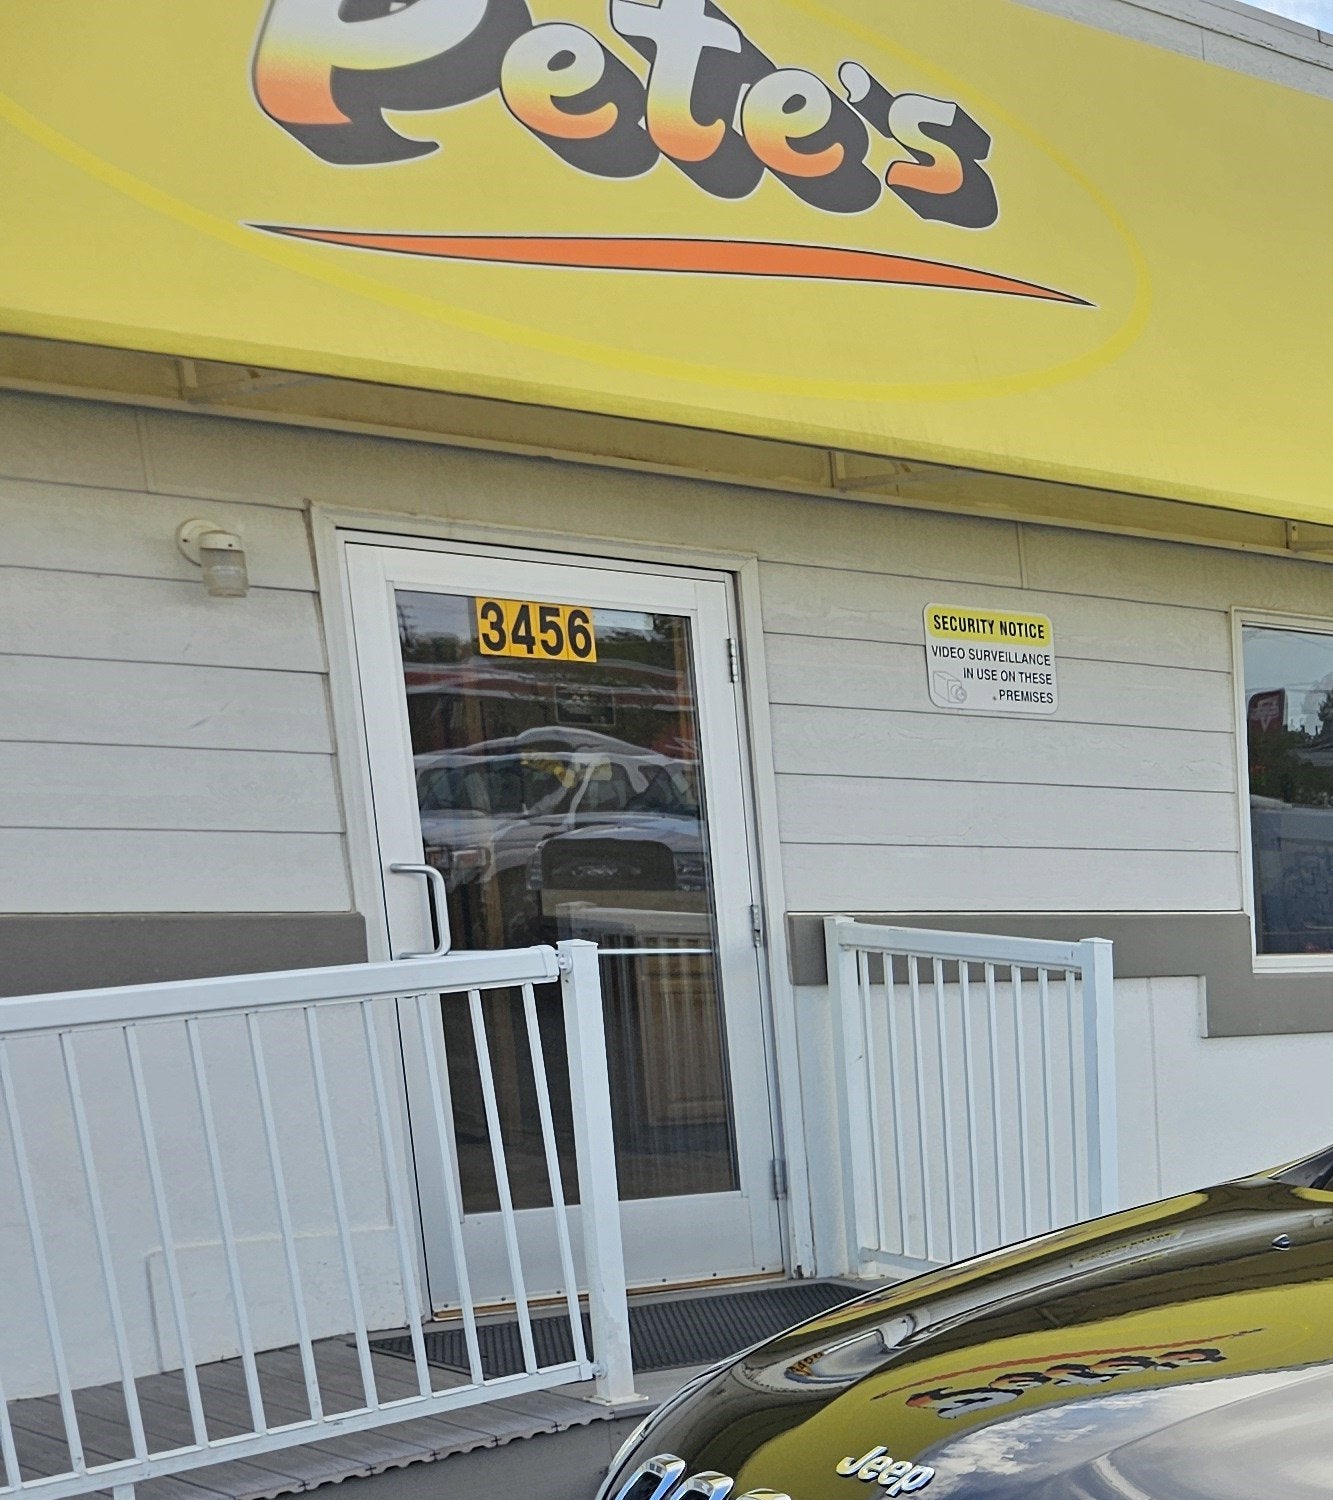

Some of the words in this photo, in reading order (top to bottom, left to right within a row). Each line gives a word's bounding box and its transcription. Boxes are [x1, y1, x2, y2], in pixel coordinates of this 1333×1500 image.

[480, 600, 593, 659] 3456
[932, 614, 995, 634] SECURITY
[999, 620, 1045, 639] NOTICE
[931, 645, 966, 659] VIDEO
[968, 648, 1051, 666] SURVEILLANCE
[963, 667, 974, 679] IN
[976, 669, 998, 681] USE
[1000, 670, 1016, 682] ON
[1019, 671, 1053, 685] THESE
[998, 689, 1054, 704] PREMISES
[836, 1446, 935, 1497] Jeep
